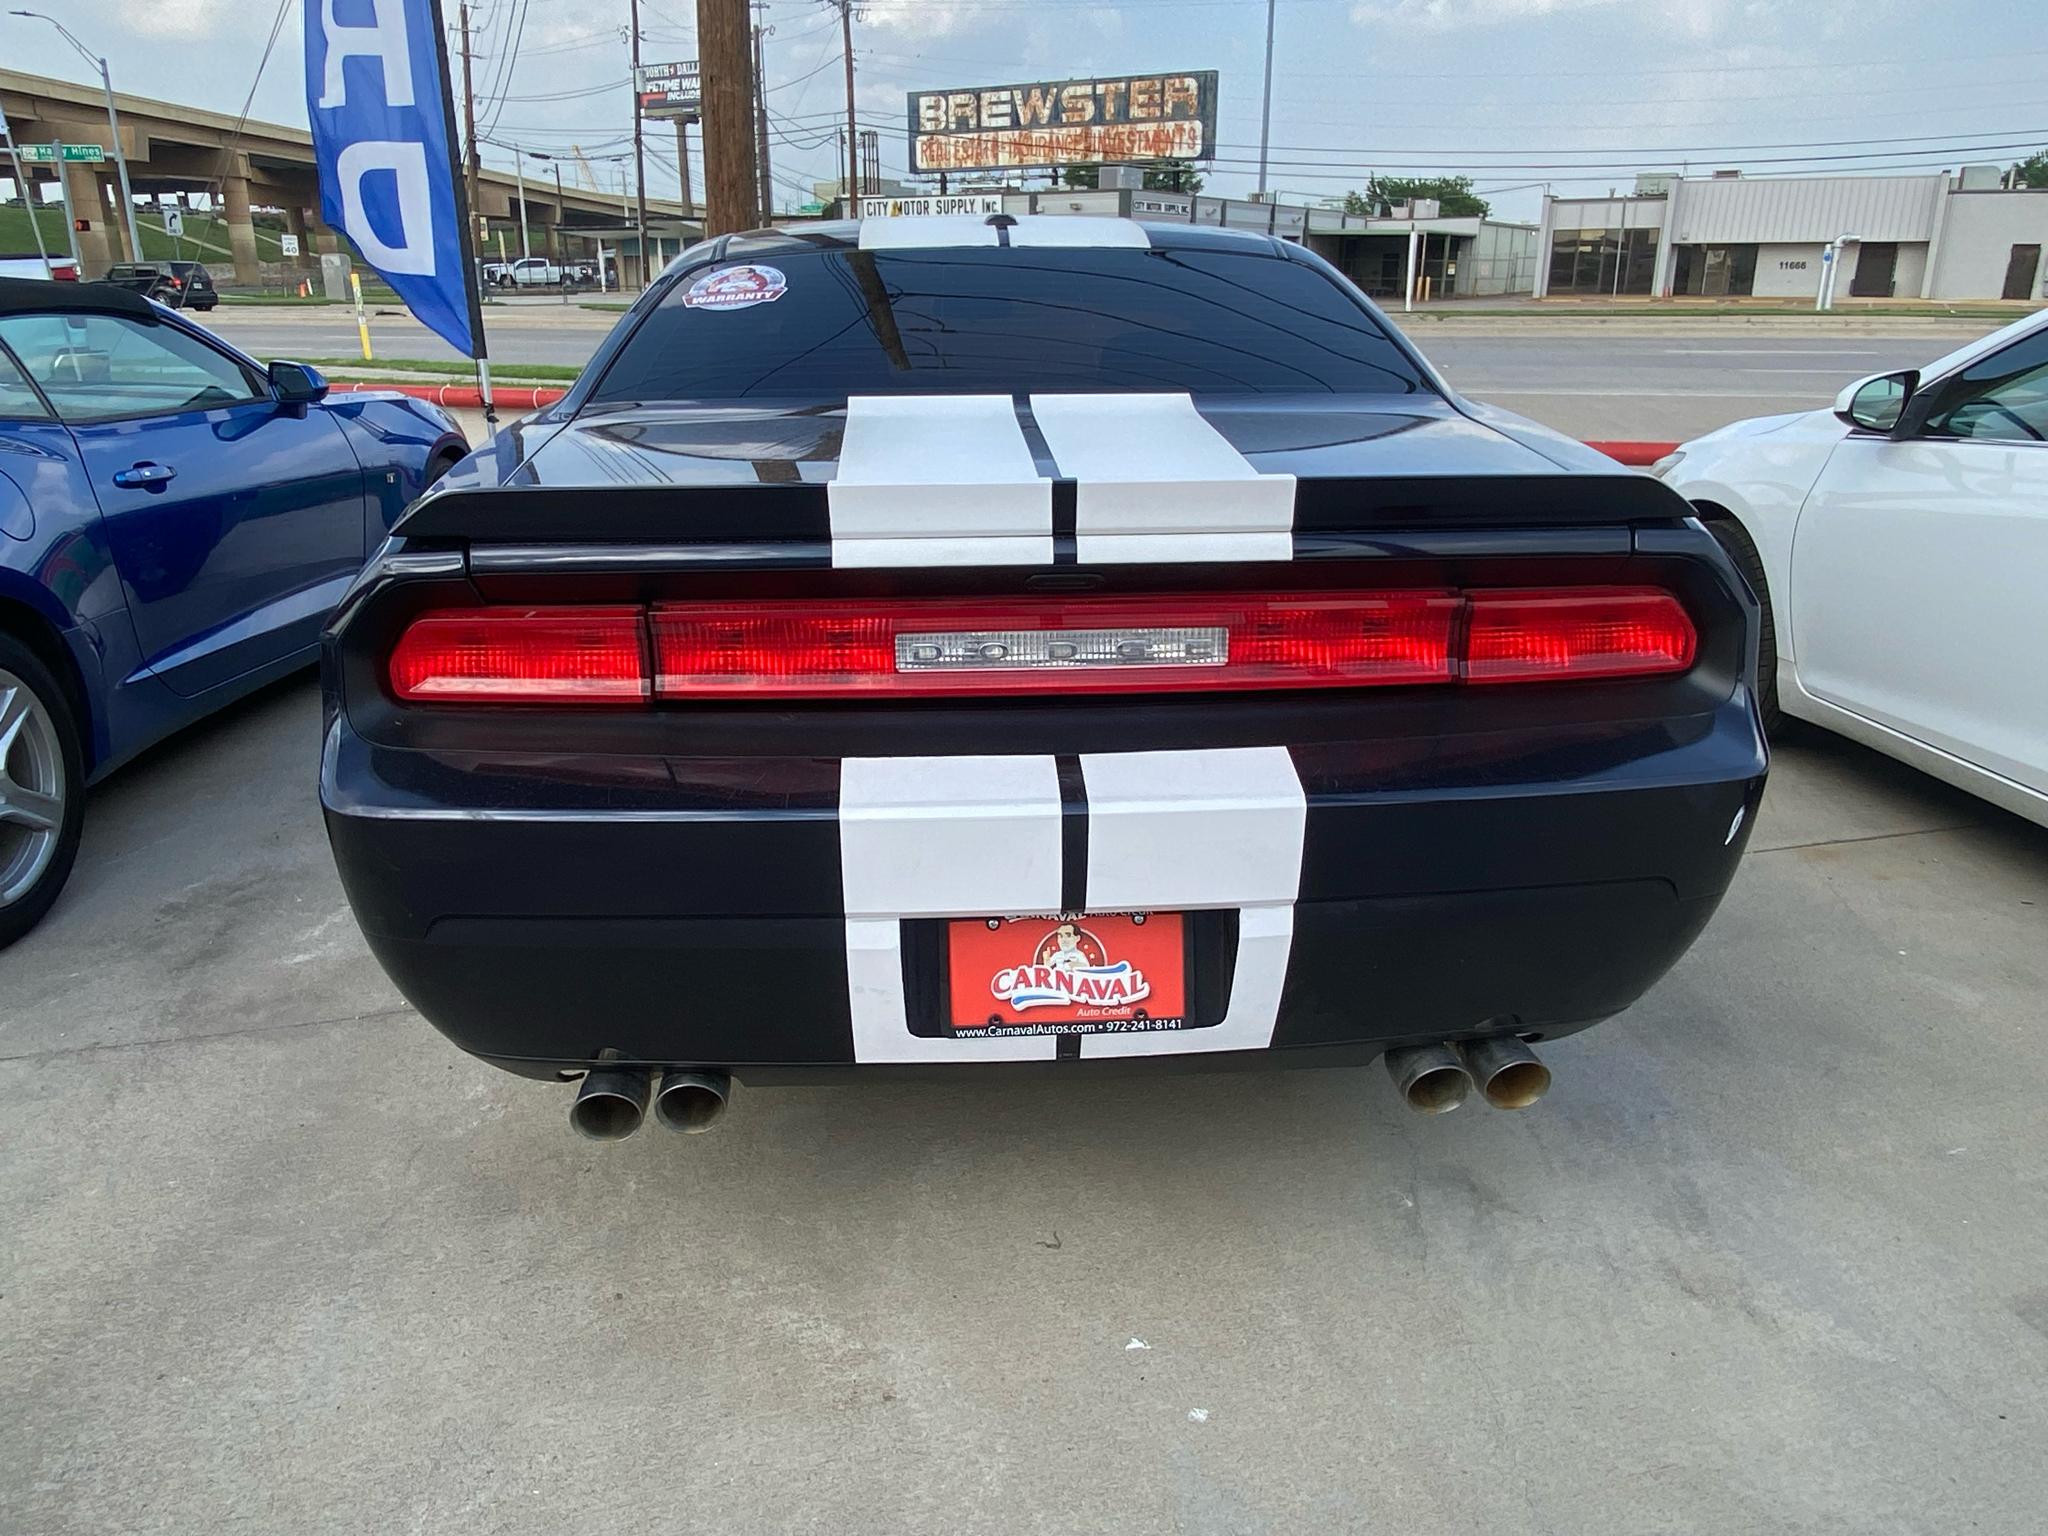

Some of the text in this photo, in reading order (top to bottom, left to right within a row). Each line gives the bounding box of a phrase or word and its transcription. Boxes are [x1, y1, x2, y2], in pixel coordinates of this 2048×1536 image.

[919, 77, 1198, 132] BREWSTER
[40, 146, 66, 157] Hay
[71, 145, 100, 156] Hines
[921, 138, 951, 163] REAL
[866, 201, 889, 217] CITY
[284, 246, 298, 254] 40
[691, 291, 774, 304] WARRANTY
[909, 638, 1213, 662] DODGE
[993, 966, 1146, 1000] CARNAVAL
[1077, 1006, 1131, 1017] Auto Credit
[955, 1019, 1182, 1038] www.CarnavalAutos.com 972-241-8141
